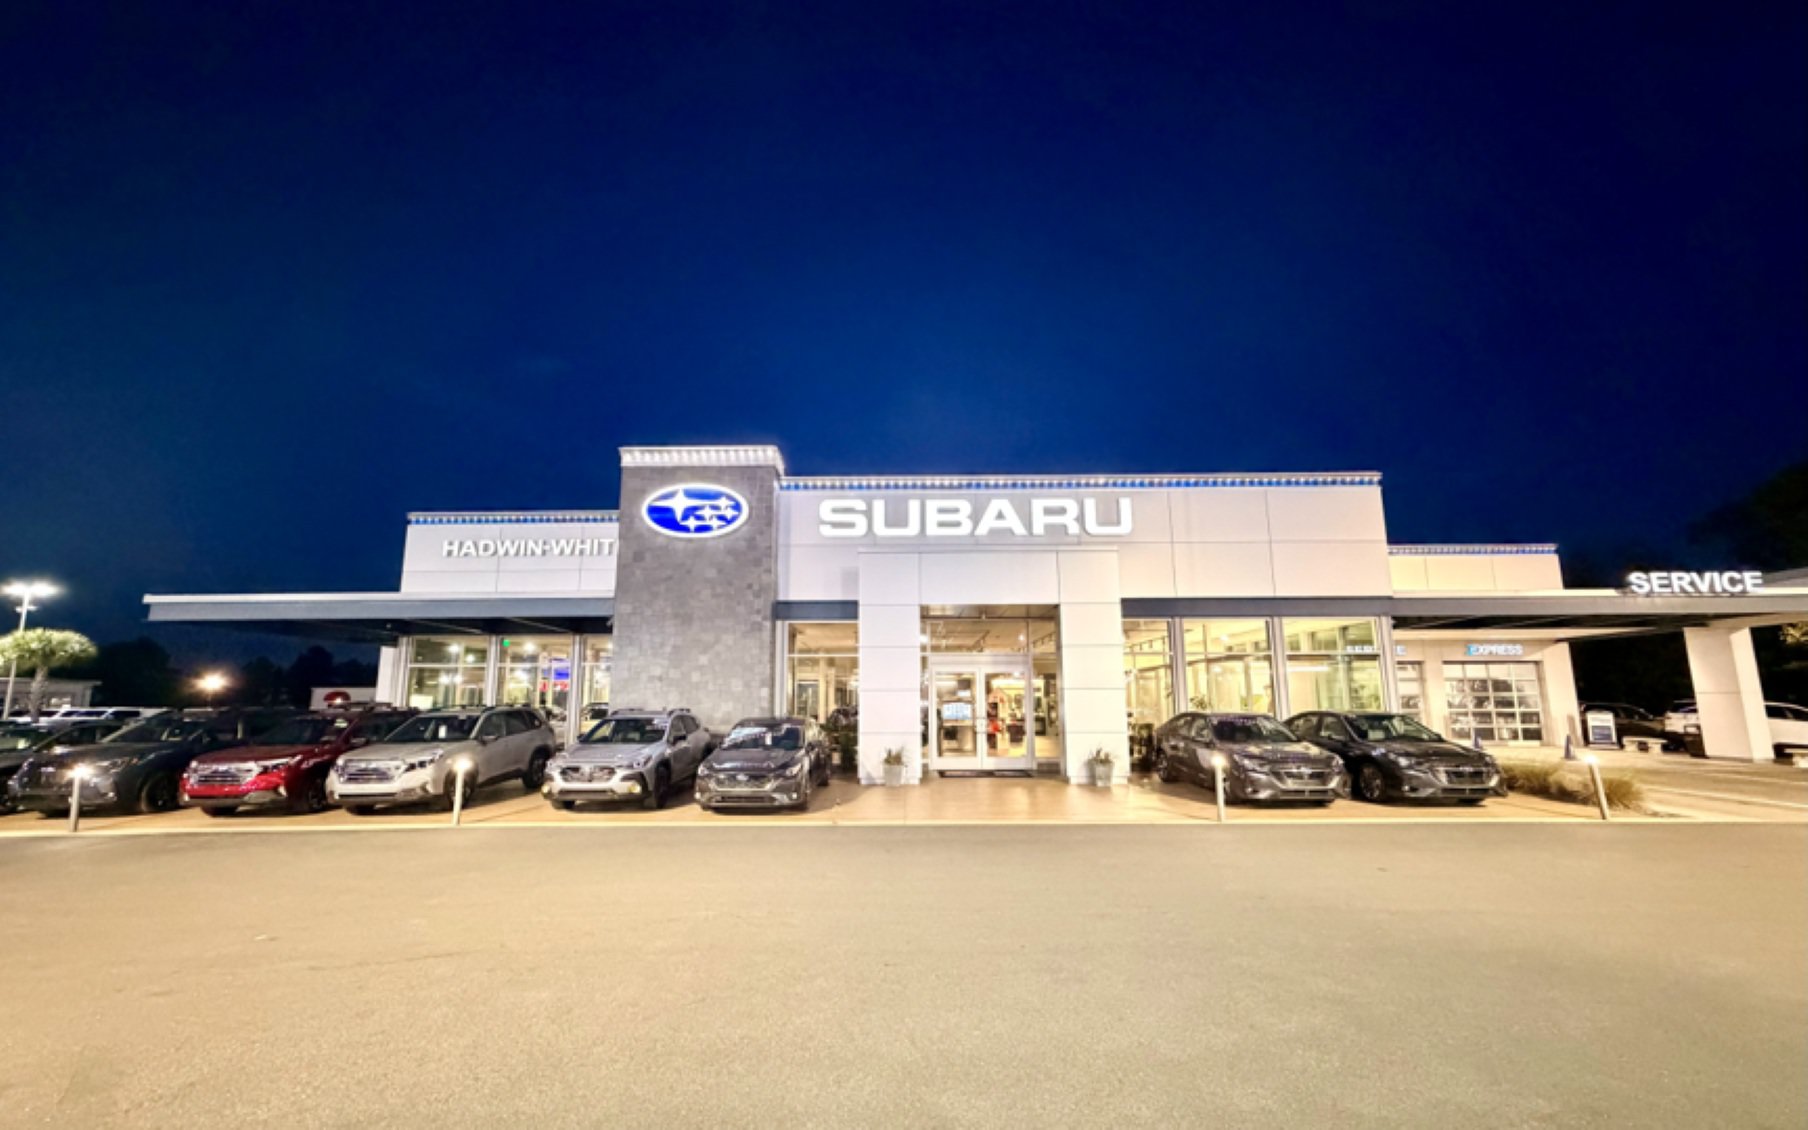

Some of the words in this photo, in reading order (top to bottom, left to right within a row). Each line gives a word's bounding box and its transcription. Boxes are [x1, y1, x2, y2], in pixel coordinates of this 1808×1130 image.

[818, 497, 1132, 537] SUBARU
[442, 538, 618, 557] HADWIN-WHIT
[1627, 570, 1763, 593] SERVICE
